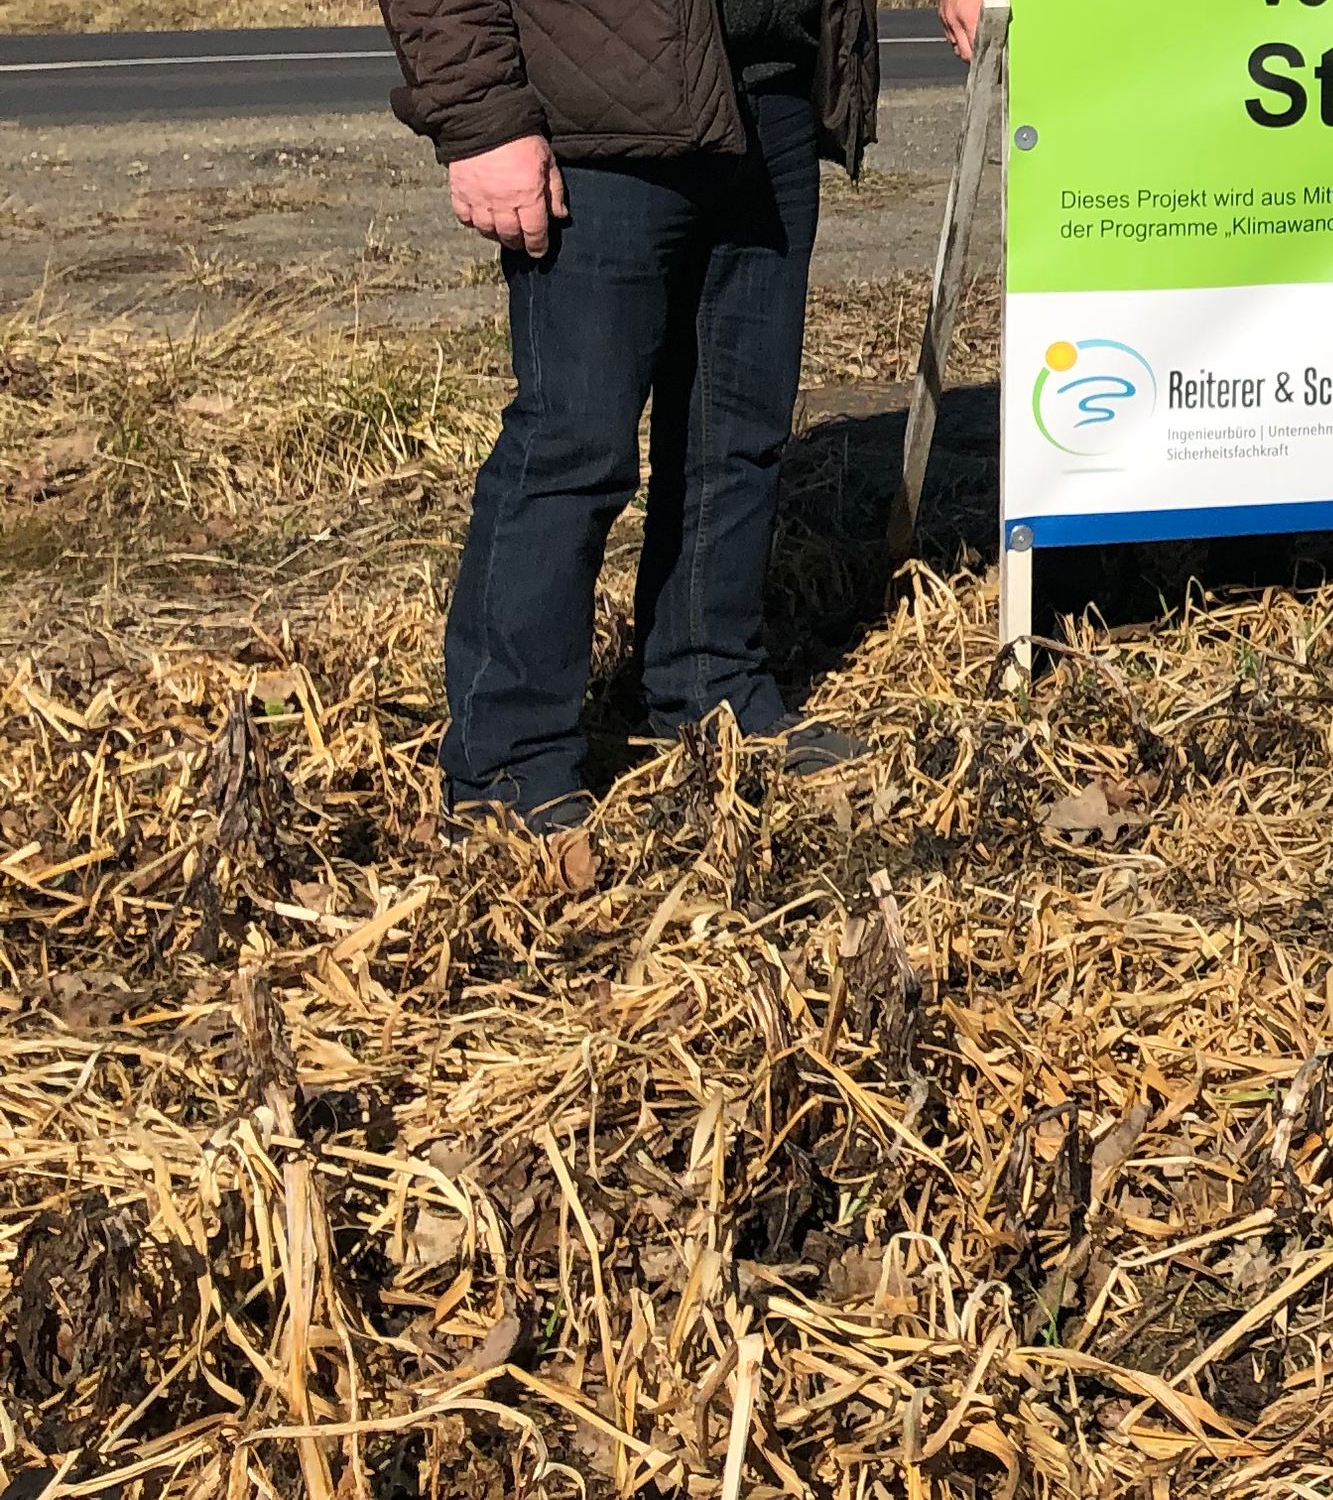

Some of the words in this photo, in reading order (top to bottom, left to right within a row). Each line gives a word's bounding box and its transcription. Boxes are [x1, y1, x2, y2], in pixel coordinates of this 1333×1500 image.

[1062, 191, 1129, 208] Dieses
[1138, 189, 1206, 212] Projekt
[1214, 188, 1253, 206] wird
[1262, 192, 1296, 206] aus
[1061, 220, 1093, 238] der
[1101, 220, 1217, 242] Programme
[1170, 370, 1265, 408] Reiterer
[1275, 372, 1293, 402] &
[1168, 427, 1258, 445] Ingenieurbüro
[1168, 442, 1288, 460] Sicherheitsfachkraft
